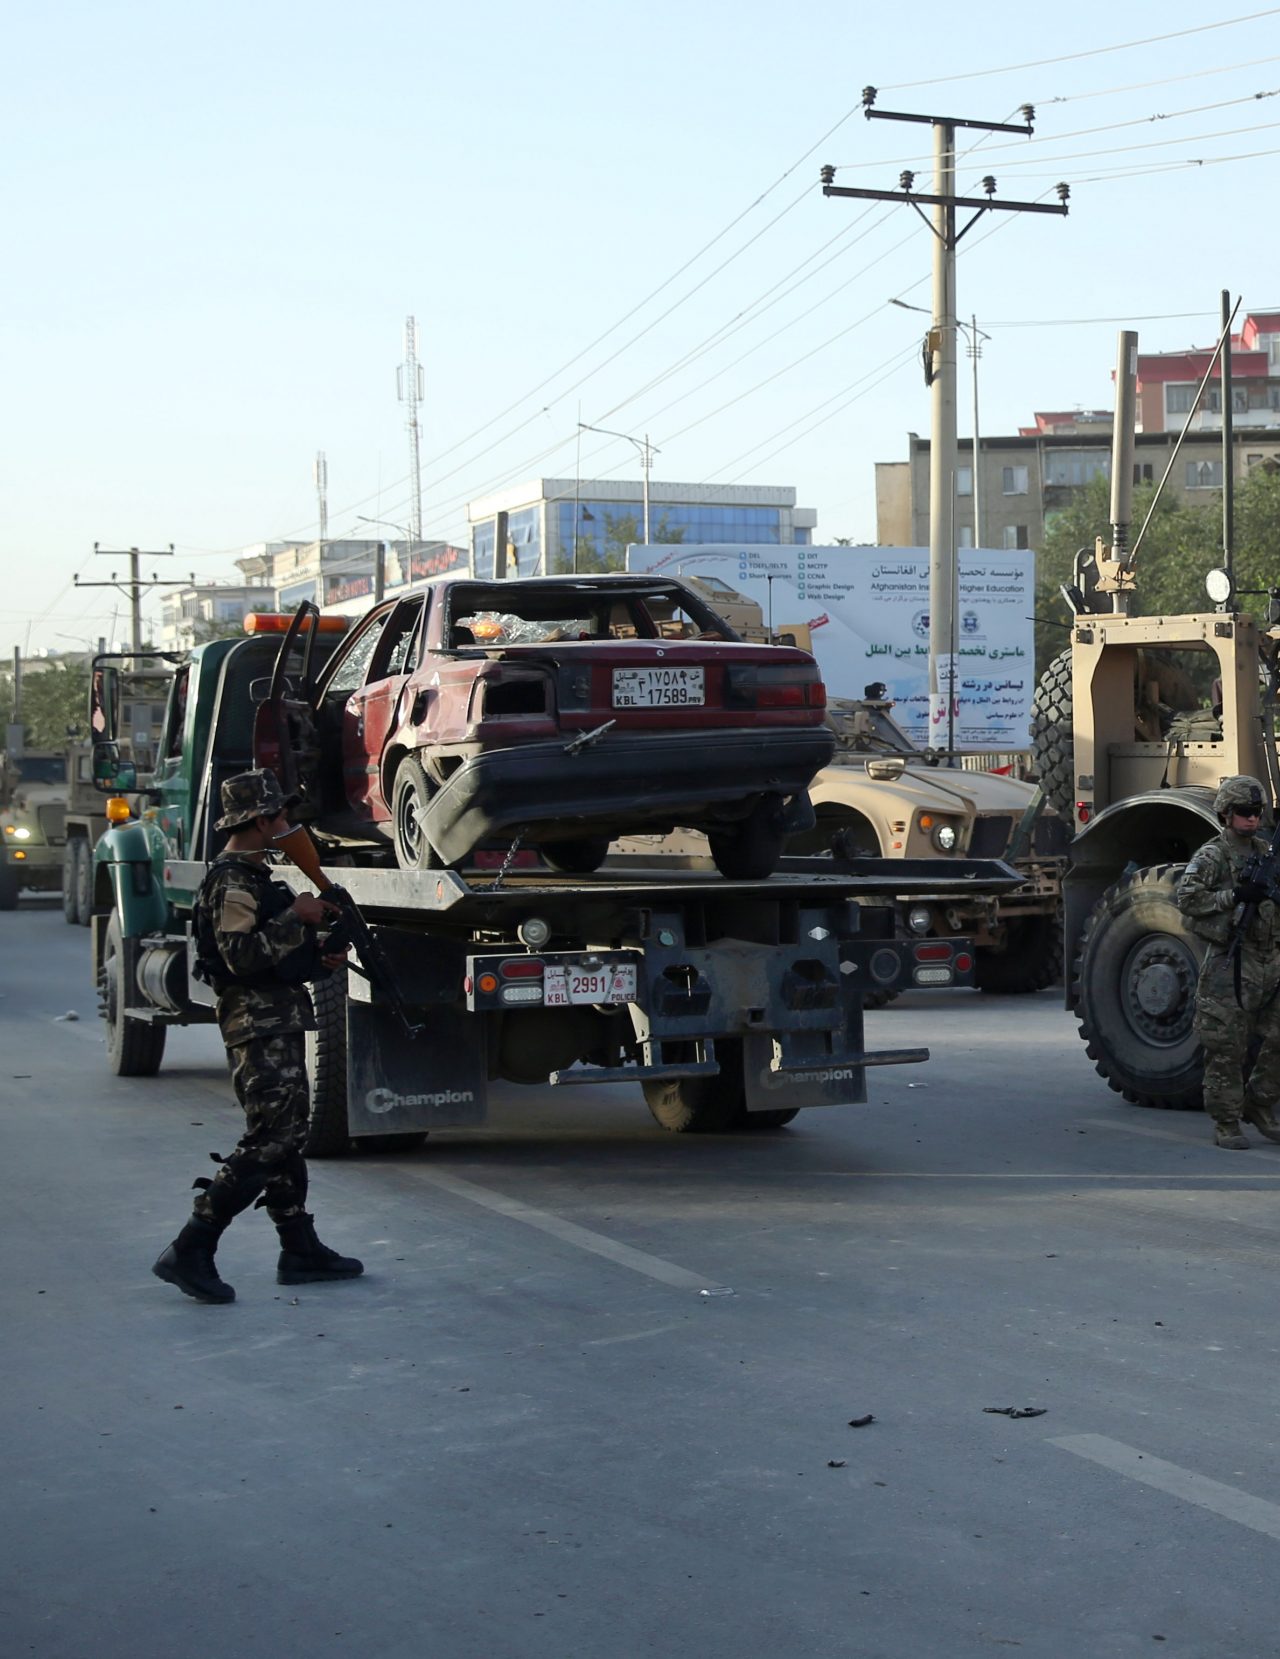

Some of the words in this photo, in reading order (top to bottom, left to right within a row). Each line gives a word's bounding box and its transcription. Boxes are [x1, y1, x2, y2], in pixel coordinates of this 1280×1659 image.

[872, 565, 917, 578] افغانستان
[871, 583, 917, 592] Afghanistan
[960, 584, 985, 593] Higher
[986, 585, 1024, 593] Education
[865, 644, 892, 657] الملل
[895, 647, 911, 658] بین
[988, 646, 1025, 660] ماستری
[962, 680, 981, 691] رشته
[982, 681, 993, 691] در
[616, 696, 637, 705] KBL
[648, 688, 687, 705] 17589
[547, 993, 567, 1004] KBL
[573, 976, 606, 993] 2991
[611, 993, 636, 1002] POLICE
[366, 1087, 474, 1114] Champion
